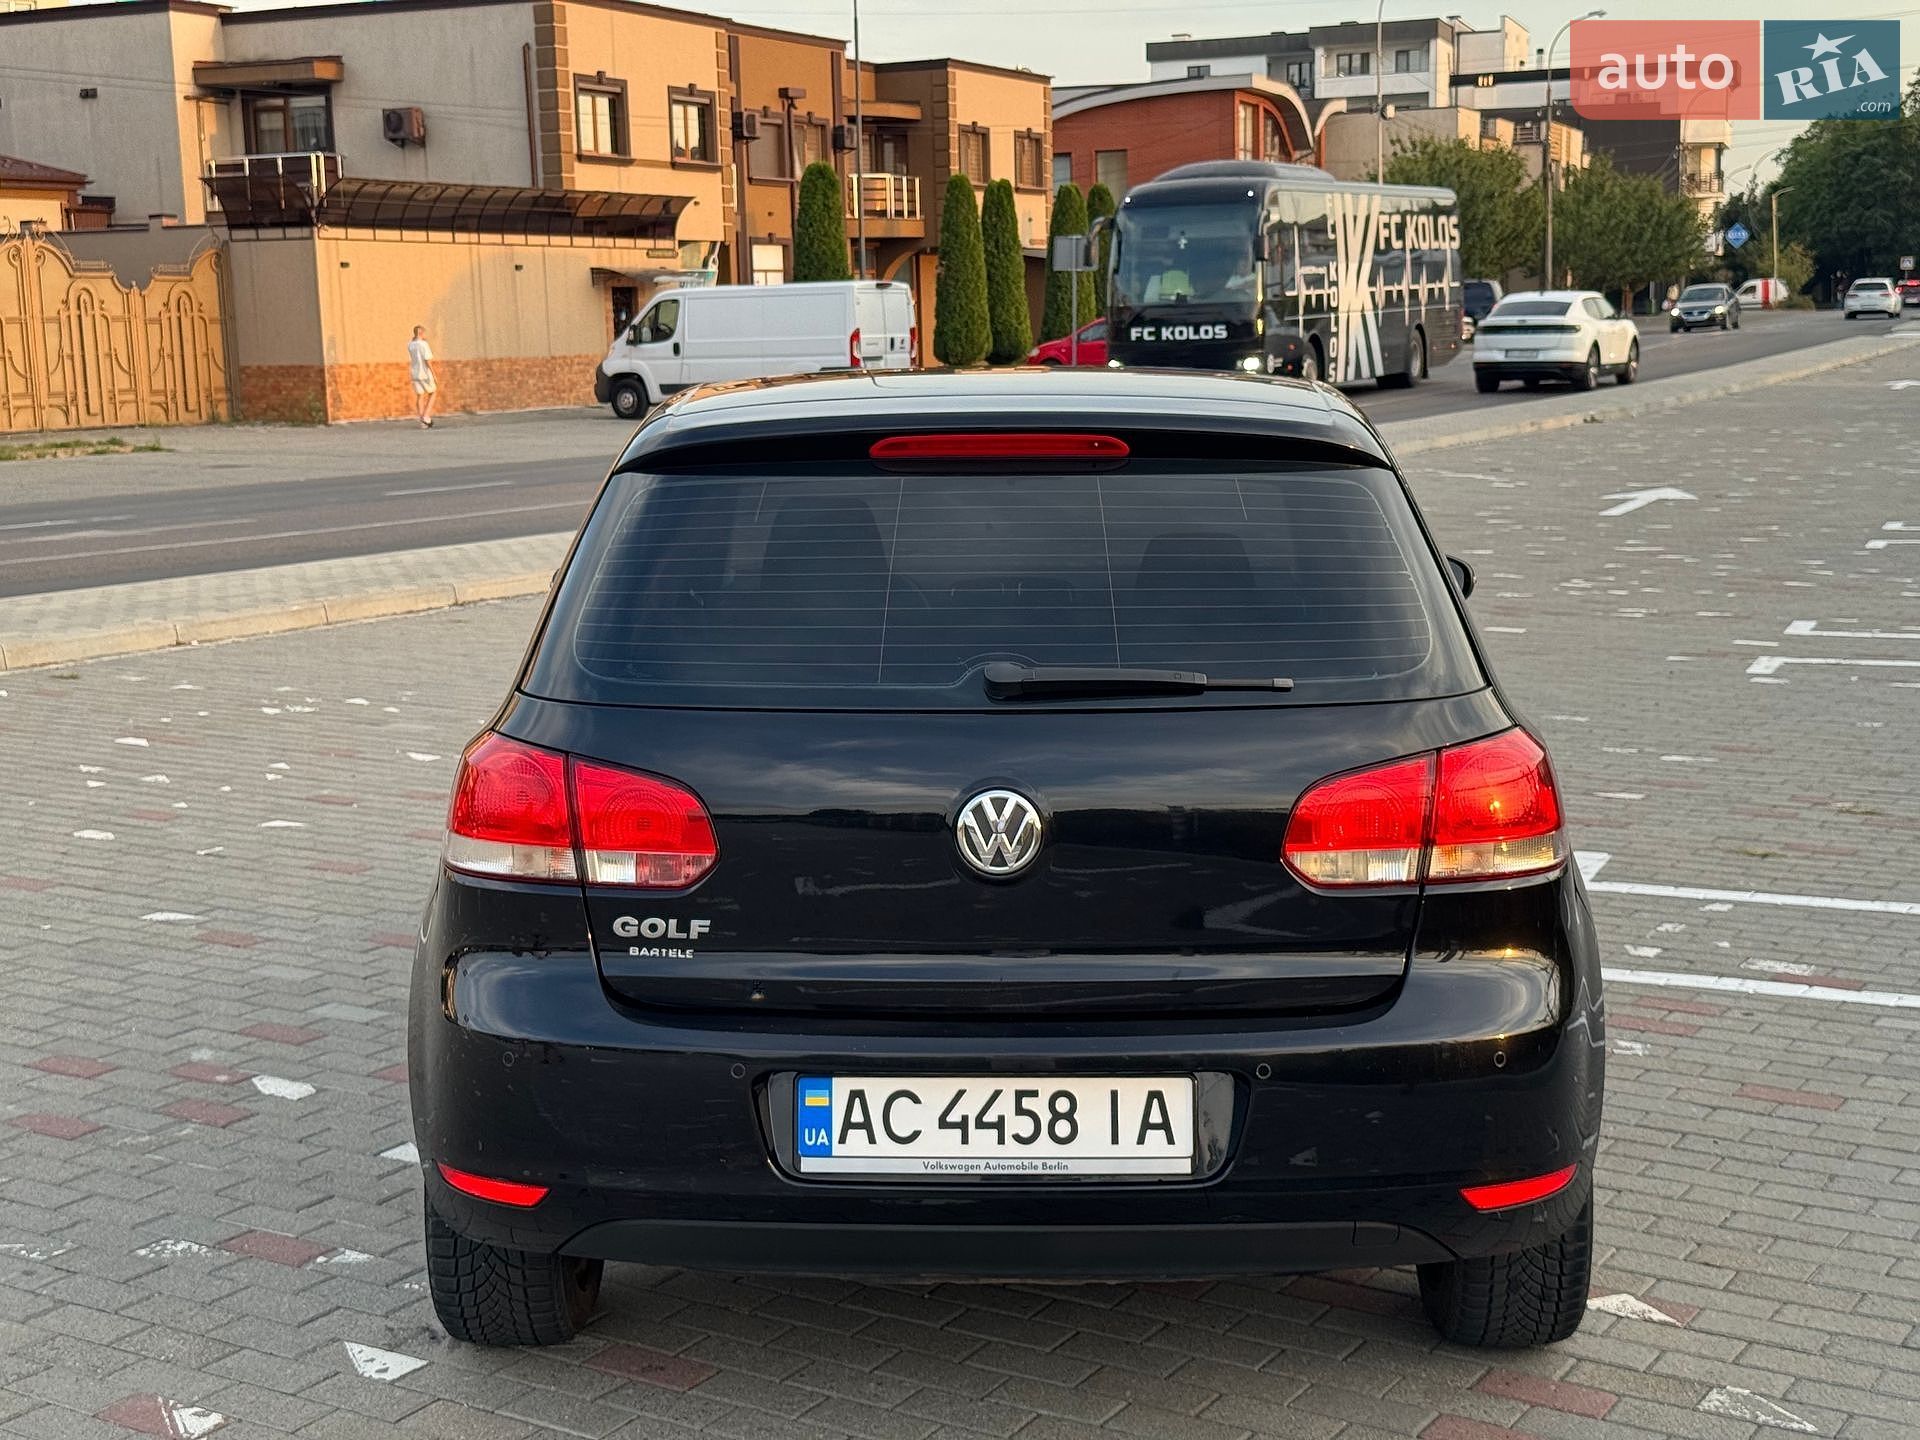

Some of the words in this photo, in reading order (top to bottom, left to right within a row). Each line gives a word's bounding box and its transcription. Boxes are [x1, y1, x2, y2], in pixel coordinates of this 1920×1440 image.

[1378, 213, 1403, 250] FC
[1405, 213, 1461, 251] KOLOS
[1130, 327, 1157, 341] FC
[1161, 324, 1228, 341] KOLOS
[612, 916, 711, 940] GOLF
[837, 1089, 923, 1145] AC
[938, 1089, 1079, 1145] 4458
[1110, 1089, 1176, 1145] IA
[804, 1128, 829, 1146] UA
[922, 1161, 981, 1172] Volkswagen
[983, 1161, 1039, 1171] Automobile
[1041, 1161, 1069, 1171] Berlin
